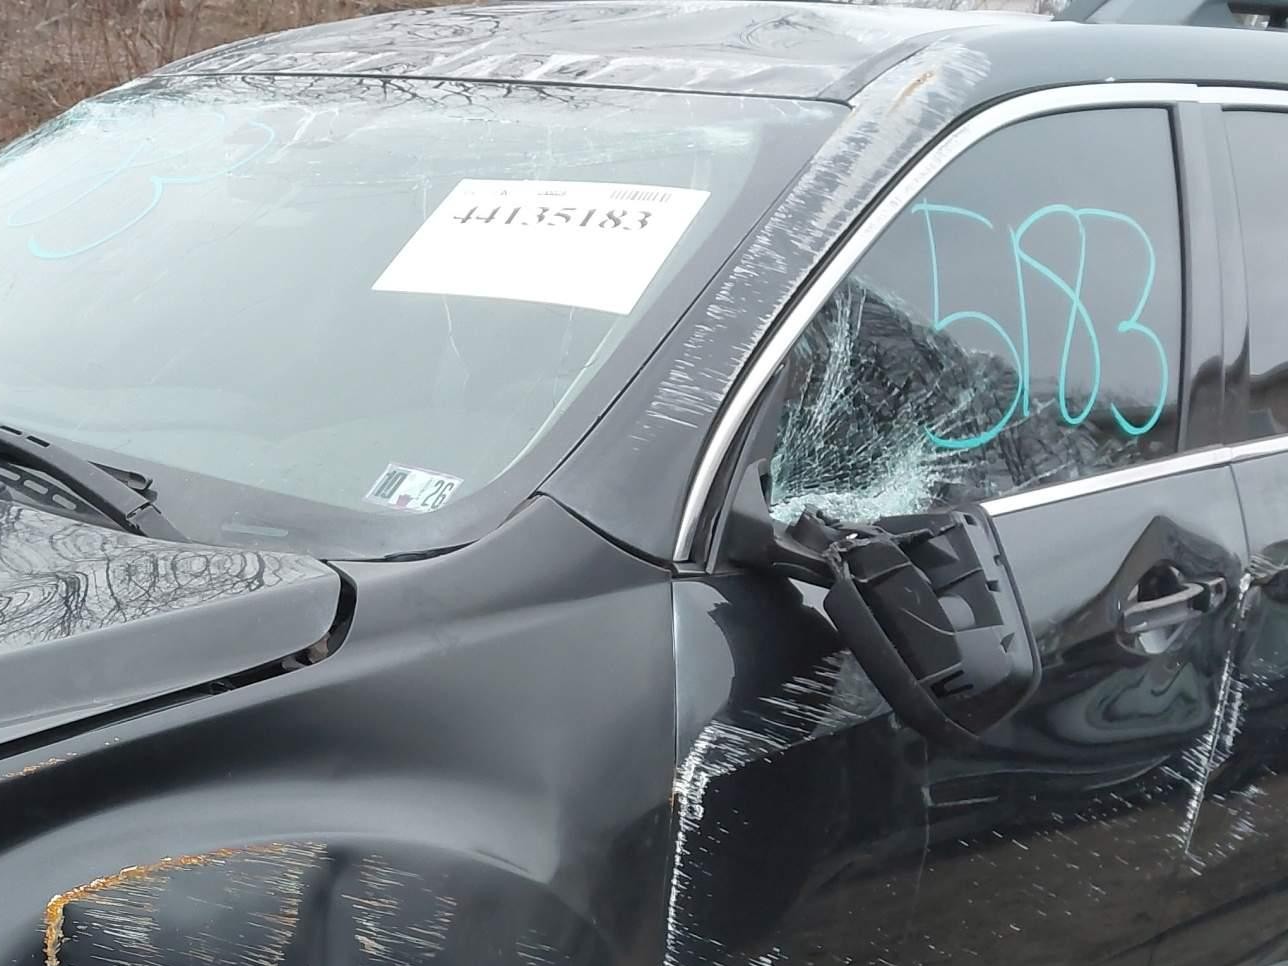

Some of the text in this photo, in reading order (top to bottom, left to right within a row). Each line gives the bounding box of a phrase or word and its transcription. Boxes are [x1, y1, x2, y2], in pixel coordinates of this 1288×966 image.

[453, 205, 653, 232] 44135183
[912, 198, 1169, 450] 5183
[374, 470, 455, 509] 10 26
